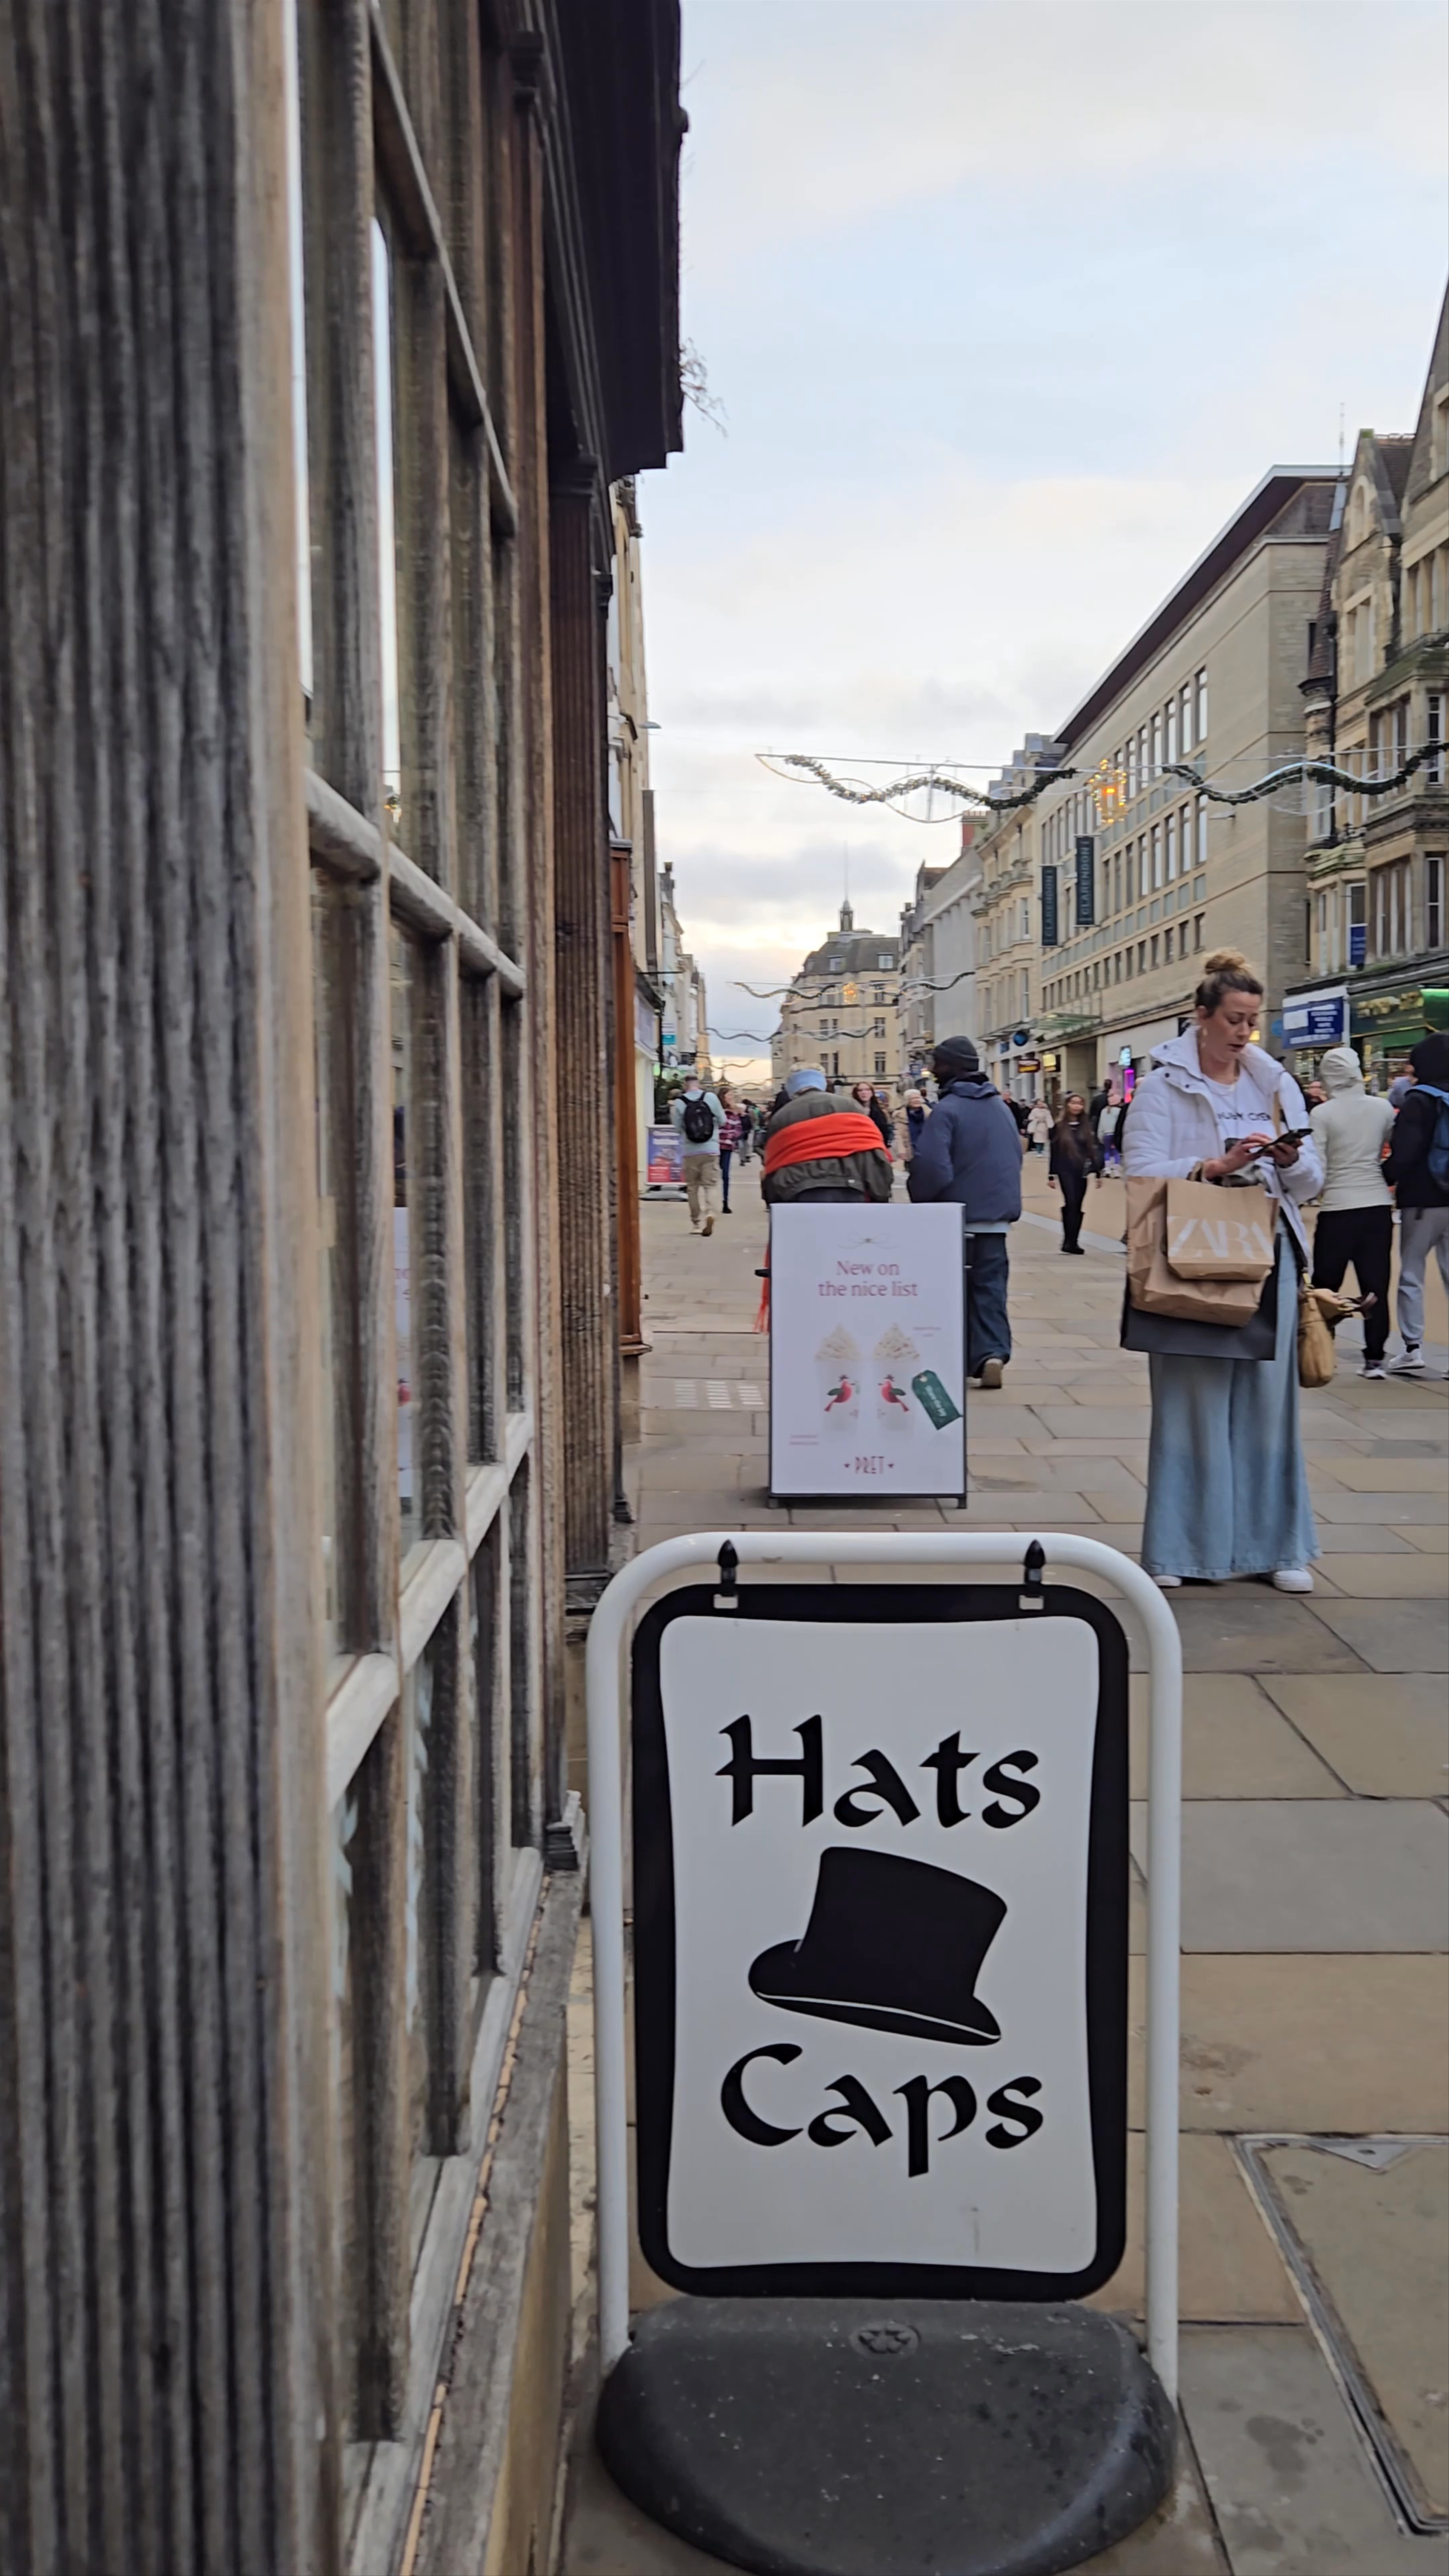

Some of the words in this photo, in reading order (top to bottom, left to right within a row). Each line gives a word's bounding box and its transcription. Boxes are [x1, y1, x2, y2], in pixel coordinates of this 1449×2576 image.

[1080, 847, 1090, 915] CLARENDON
[1167, 1216, 1274, 1260] ZARA
[818, 1281, 847, 1296] the
[851, 1281, 888, 1296] nice
[892, 1281, 918, 1296] list
[836, 1261, 874, 1275] New
[878, 1264, 900, 1276] on
[855, 1456, 885, 1475] PRET
[715, 1715, 1041, 1829] Hats
[720, 2043, 1044, 2178] Caps
